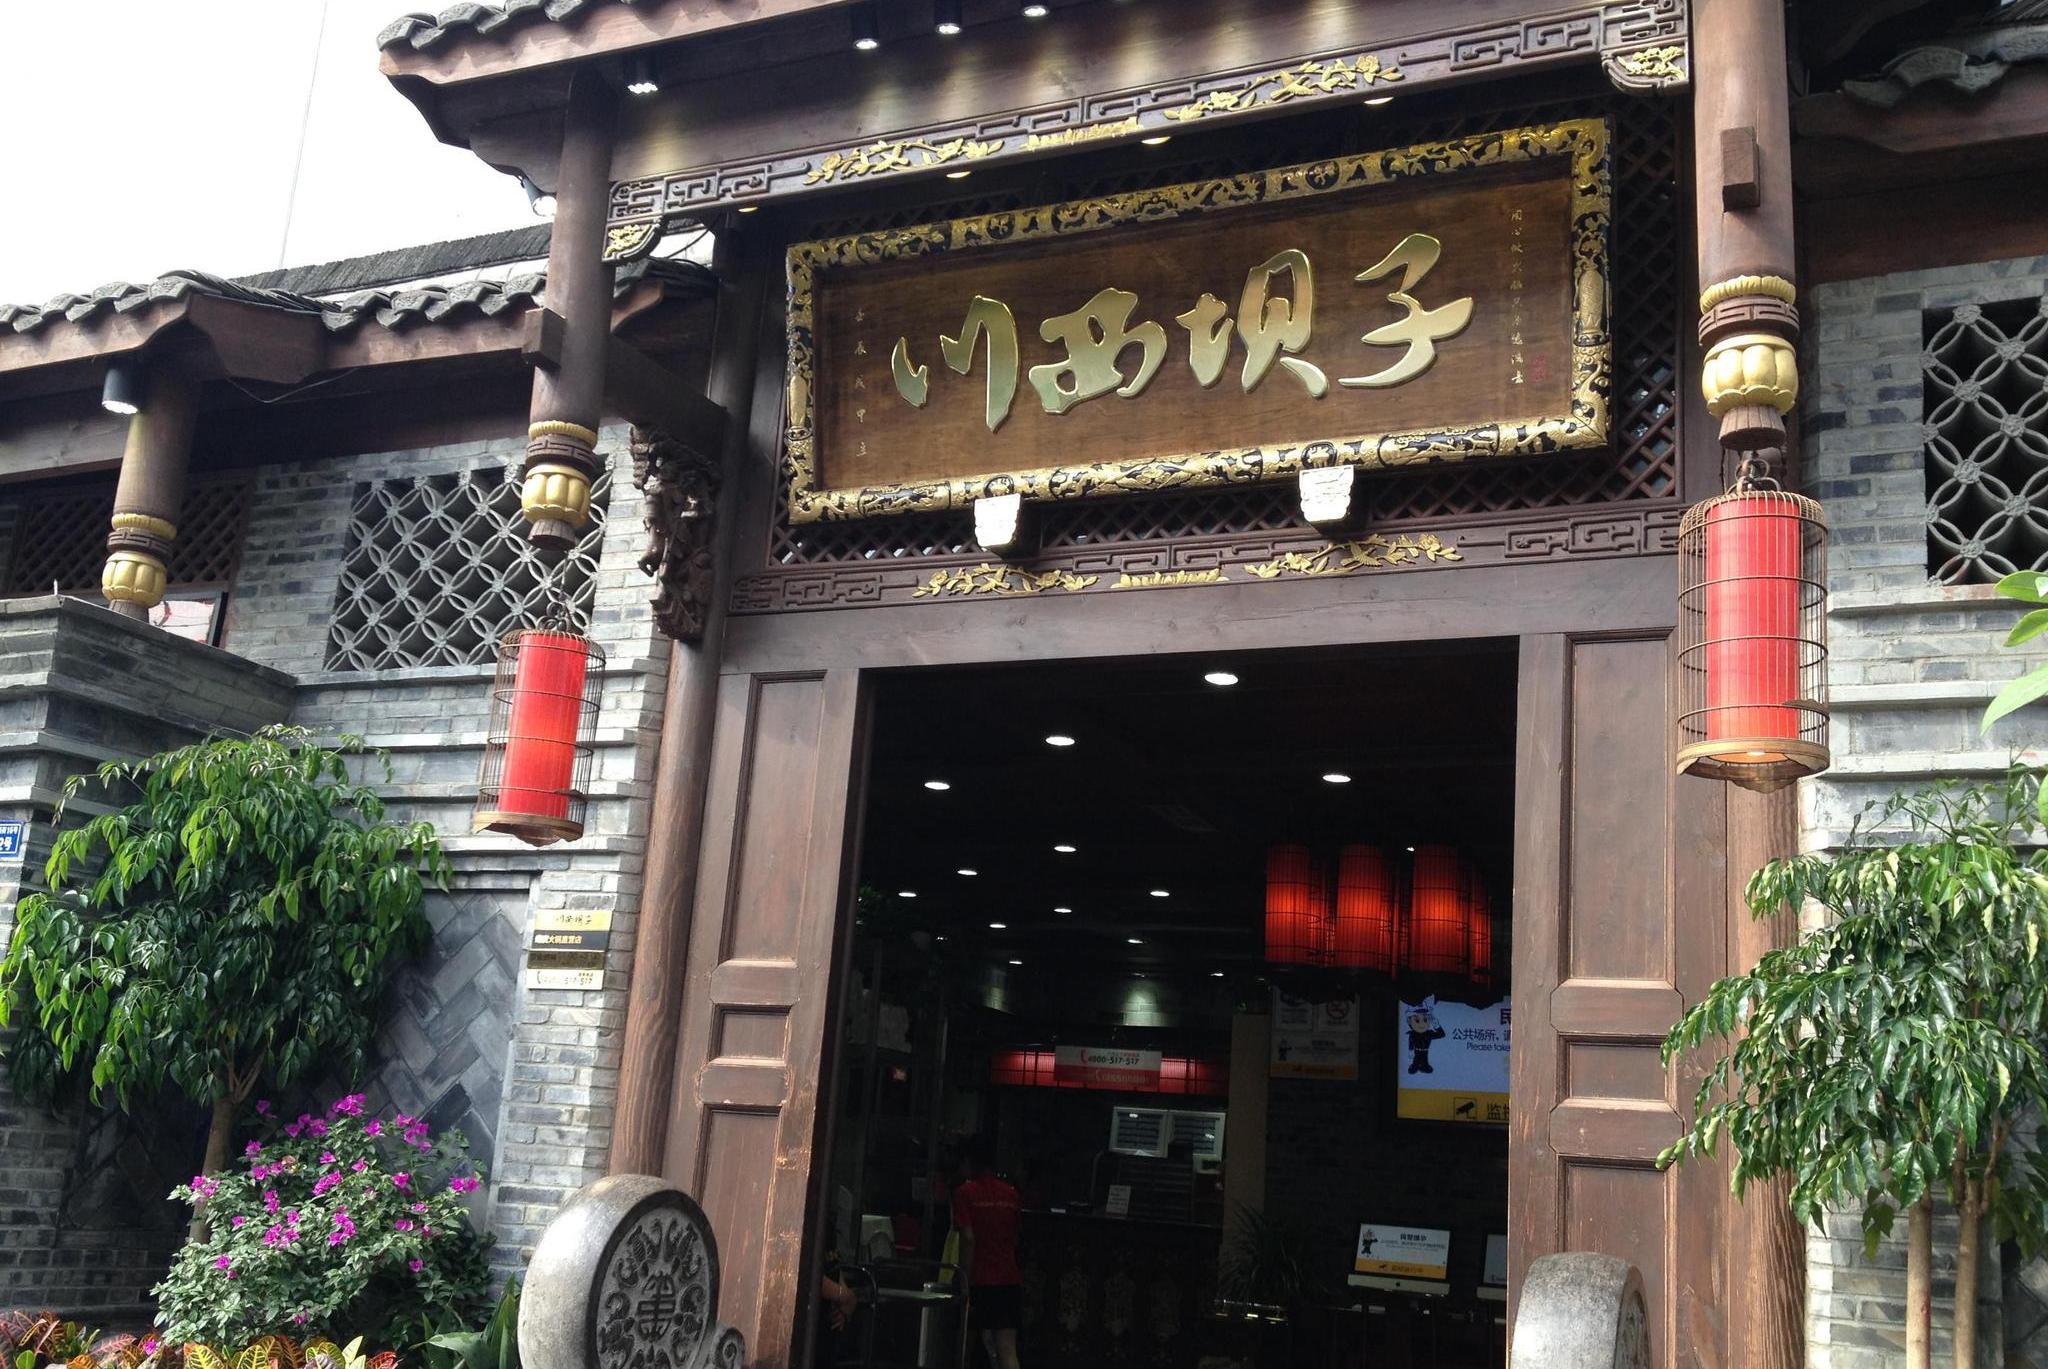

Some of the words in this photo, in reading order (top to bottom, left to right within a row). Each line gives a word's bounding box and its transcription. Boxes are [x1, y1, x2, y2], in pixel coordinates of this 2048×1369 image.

[890, 232, 1474, 432] 川西坝子
[1466, 1042, 1493, 1052] Please
